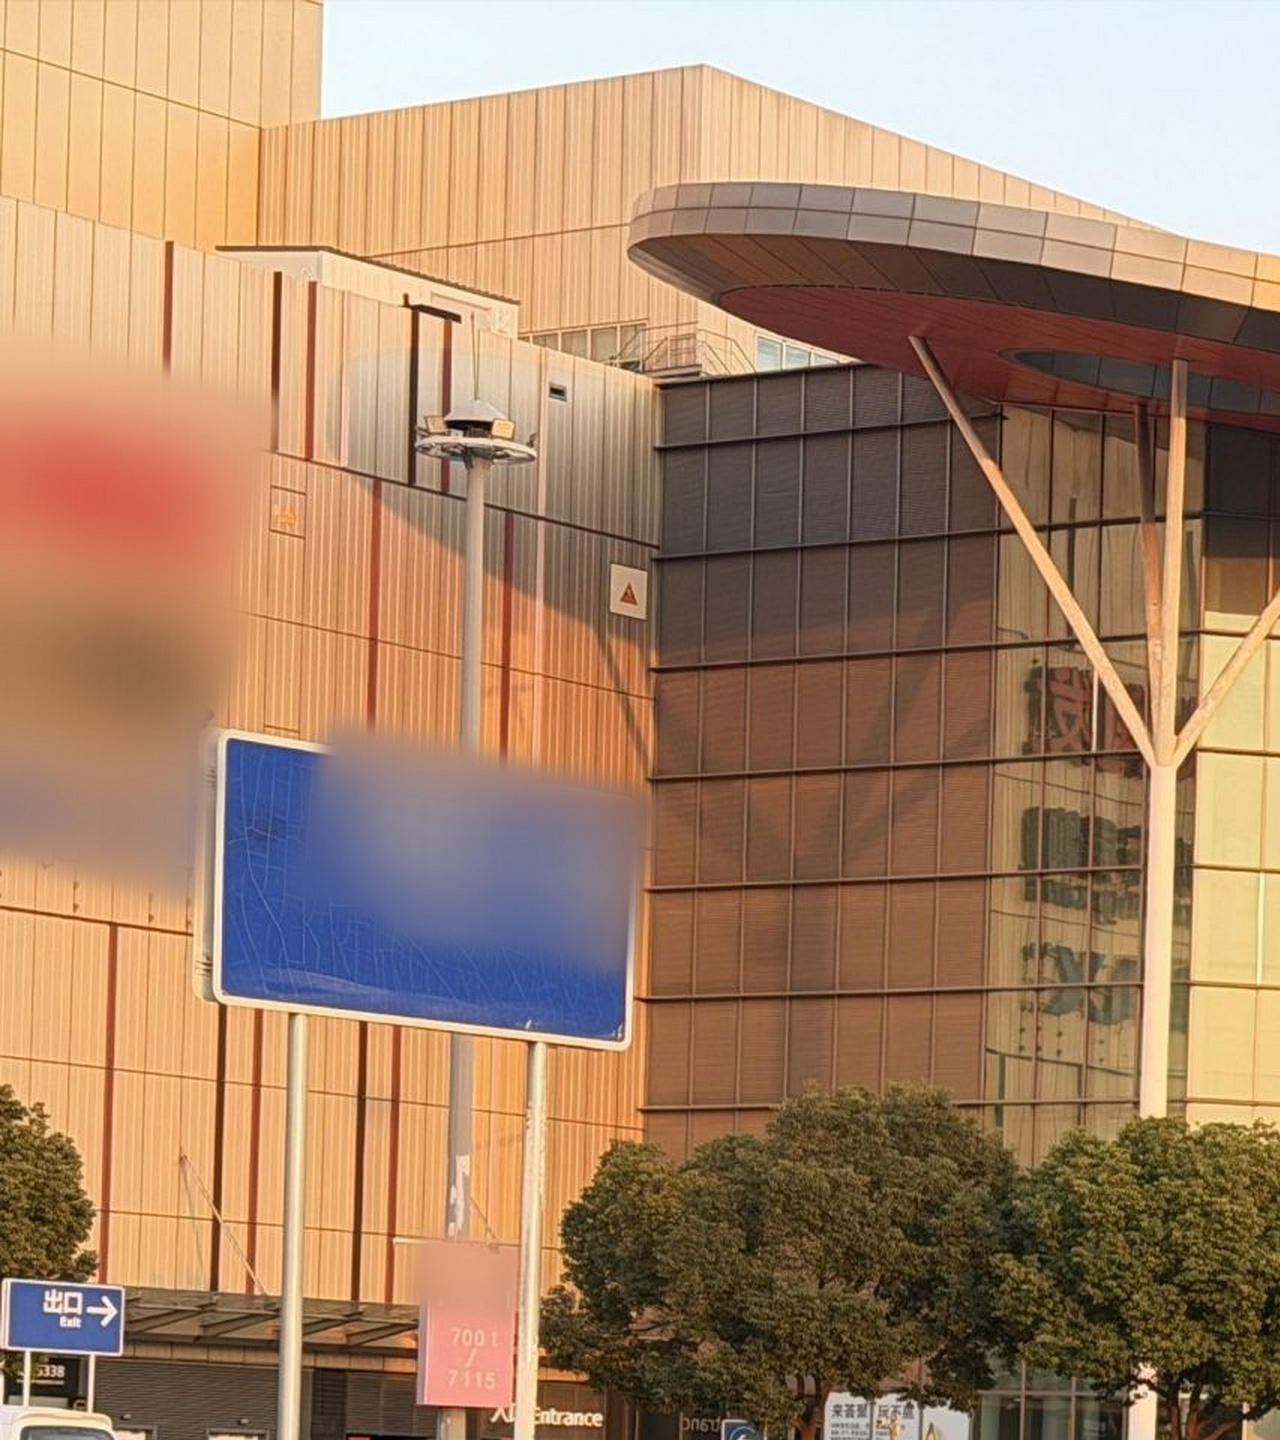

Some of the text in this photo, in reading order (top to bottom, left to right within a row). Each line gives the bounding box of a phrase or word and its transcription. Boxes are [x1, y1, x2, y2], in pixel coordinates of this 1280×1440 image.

[43, 1289, 83, 1315] 出口
[60, 1316, 82, 1328] Exit
[448, 1370, 496, 1391] 7115
